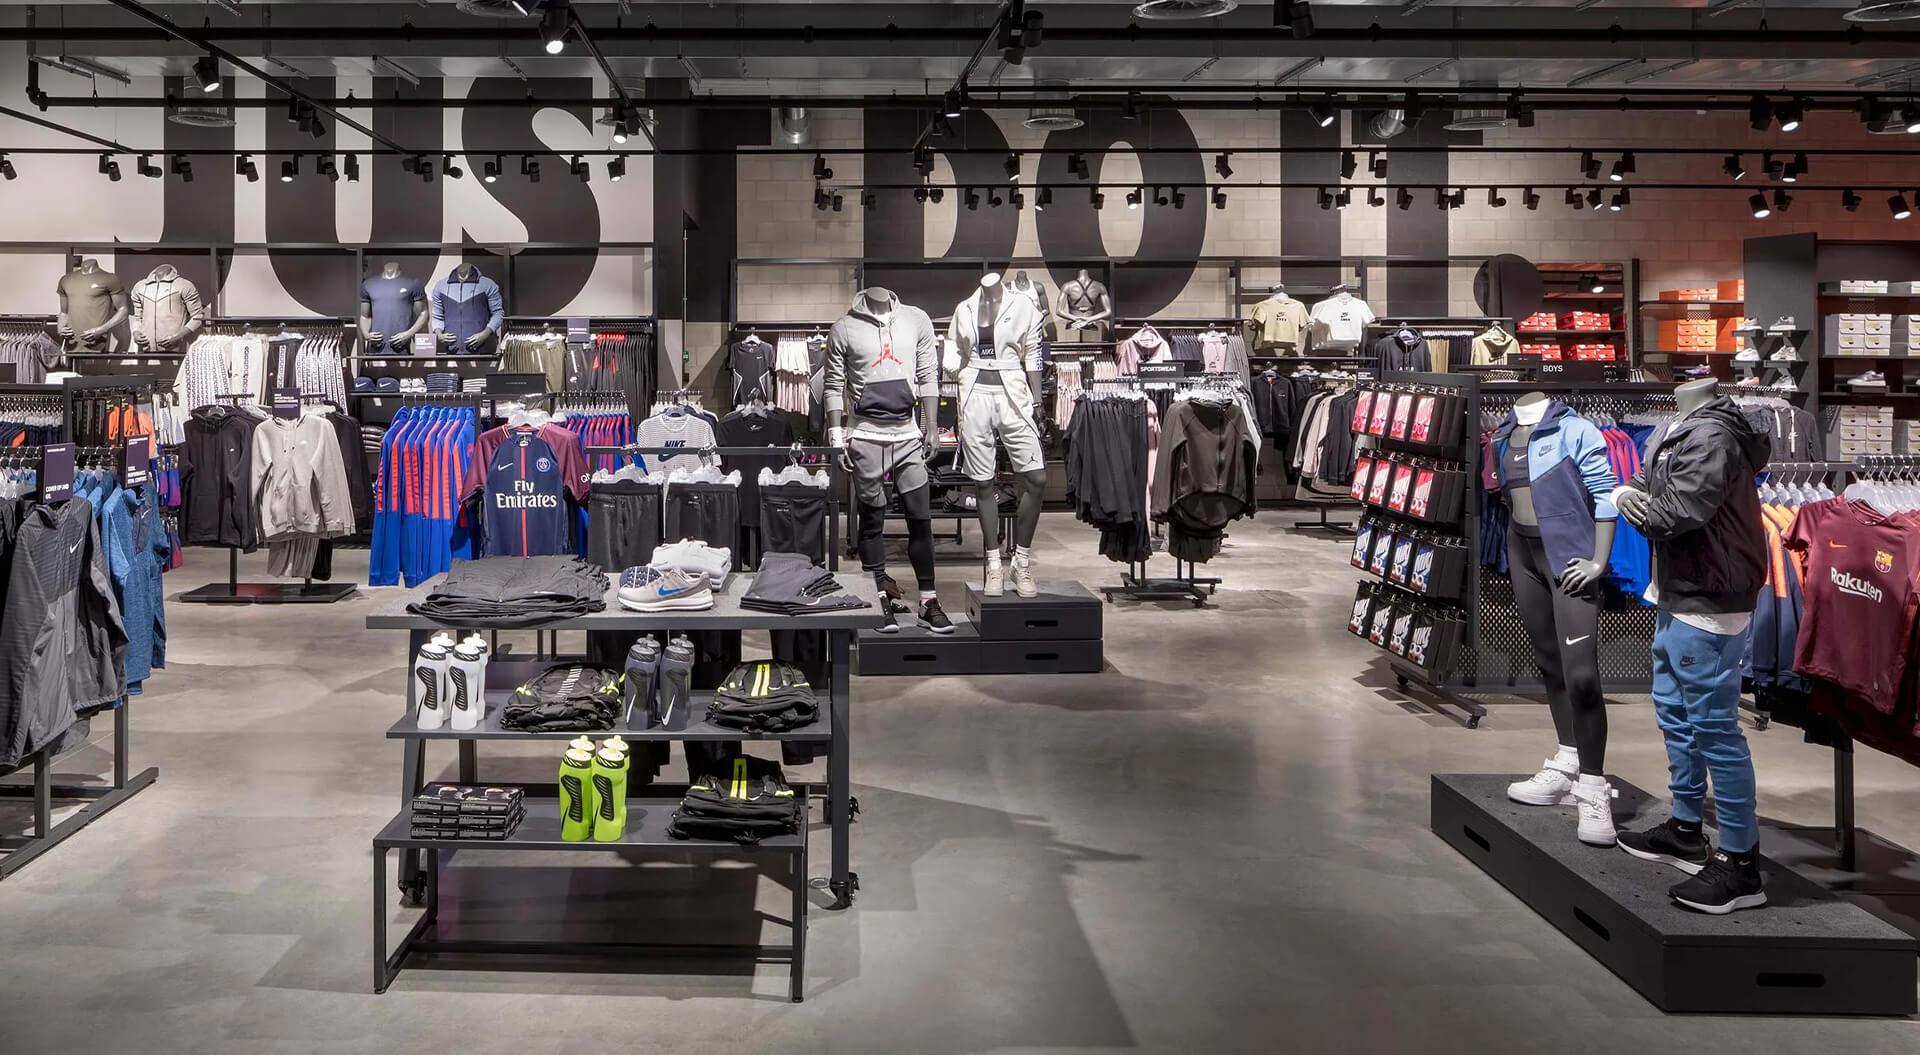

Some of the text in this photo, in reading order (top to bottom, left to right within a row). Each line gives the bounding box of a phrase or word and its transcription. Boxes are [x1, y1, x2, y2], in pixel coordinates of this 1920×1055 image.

[864, 94, 1206, 321] DO
[1543, 365, 1563, 373] BOYS
[514, 480, 534, 493] Fly
[496, 493, 557, 508] Emirates
[1831, 567, 1883, 603] Rakuten
